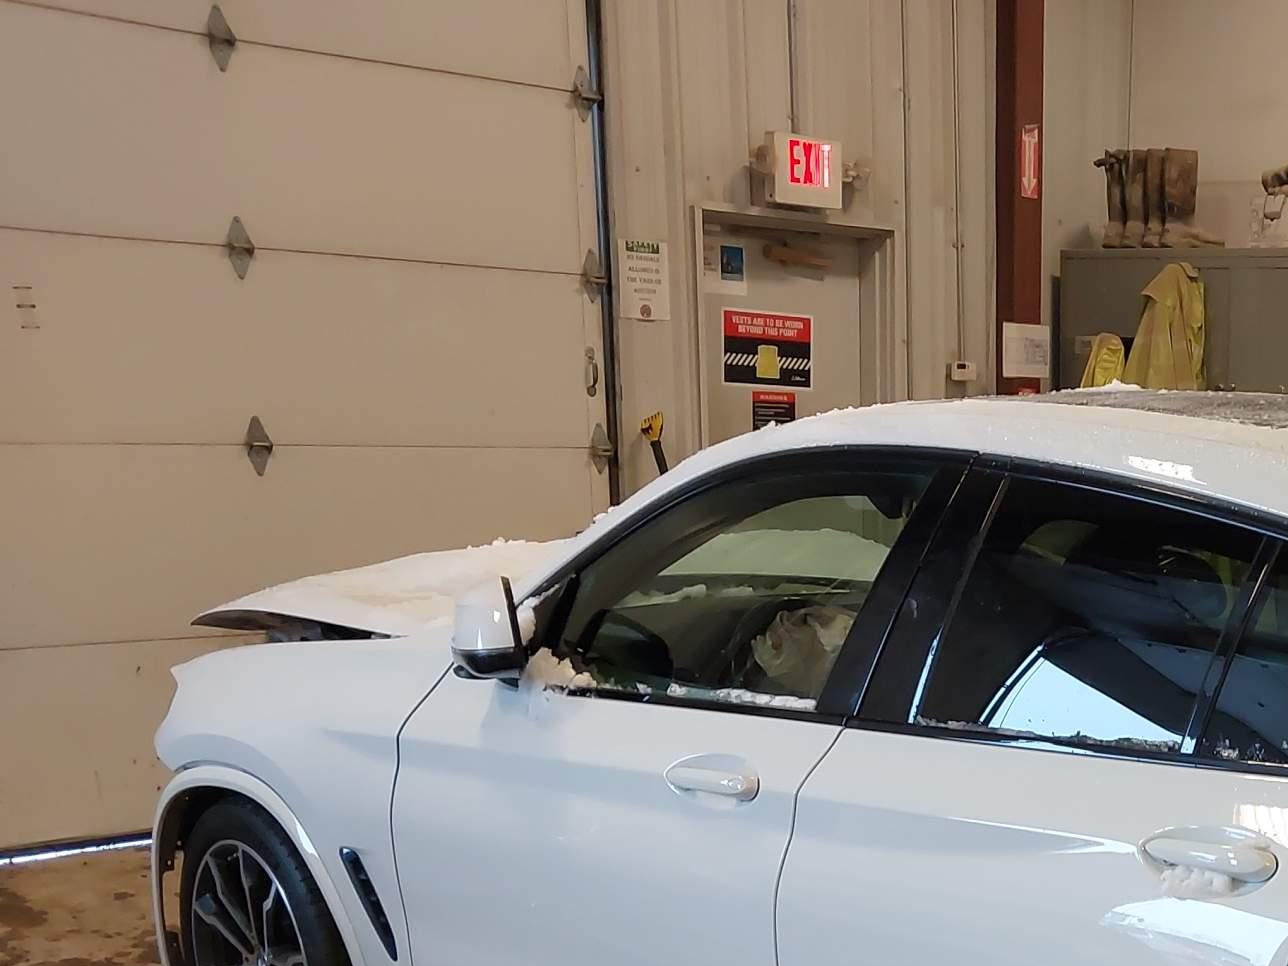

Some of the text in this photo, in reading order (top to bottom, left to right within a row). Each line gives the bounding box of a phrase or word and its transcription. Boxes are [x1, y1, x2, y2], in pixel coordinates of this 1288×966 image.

[788, 139, 832, 189] EXIT
[732, 315, 752, 325] VESTS
[752, 317, 765, 326] ARE
[766, 318, 775, 327] TO
[738, 325, 798, 337] BEYOND THIS POINT
